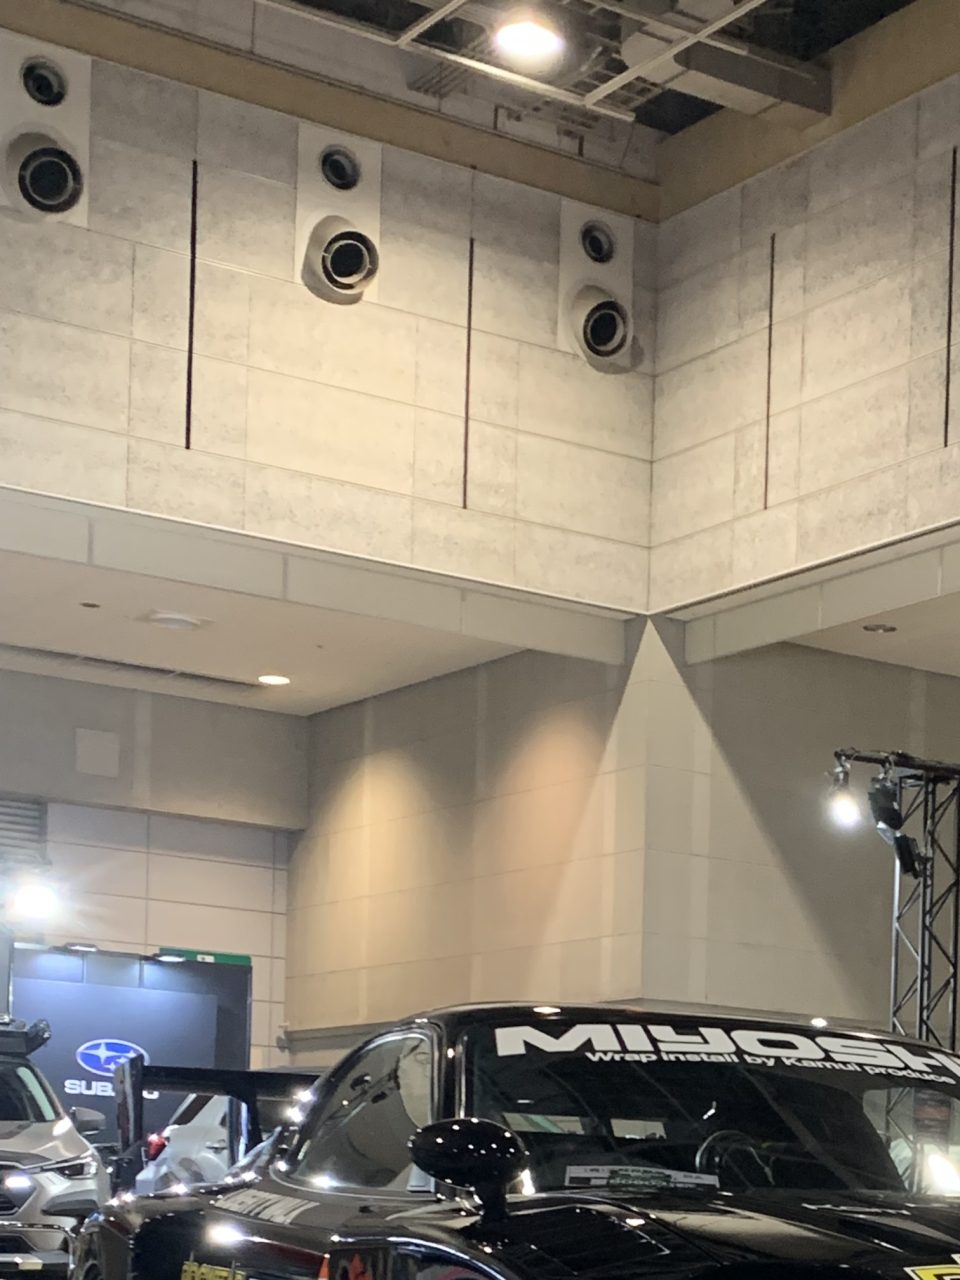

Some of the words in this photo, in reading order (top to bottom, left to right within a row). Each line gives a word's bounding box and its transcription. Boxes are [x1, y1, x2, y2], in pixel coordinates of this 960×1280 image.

[585, 1051, 658, 1063] Wrap
[744, 1054, 775, 1067] by
[866, 1064, 957, 1085] produce
[64, 1078, 160, 1100] SUB
